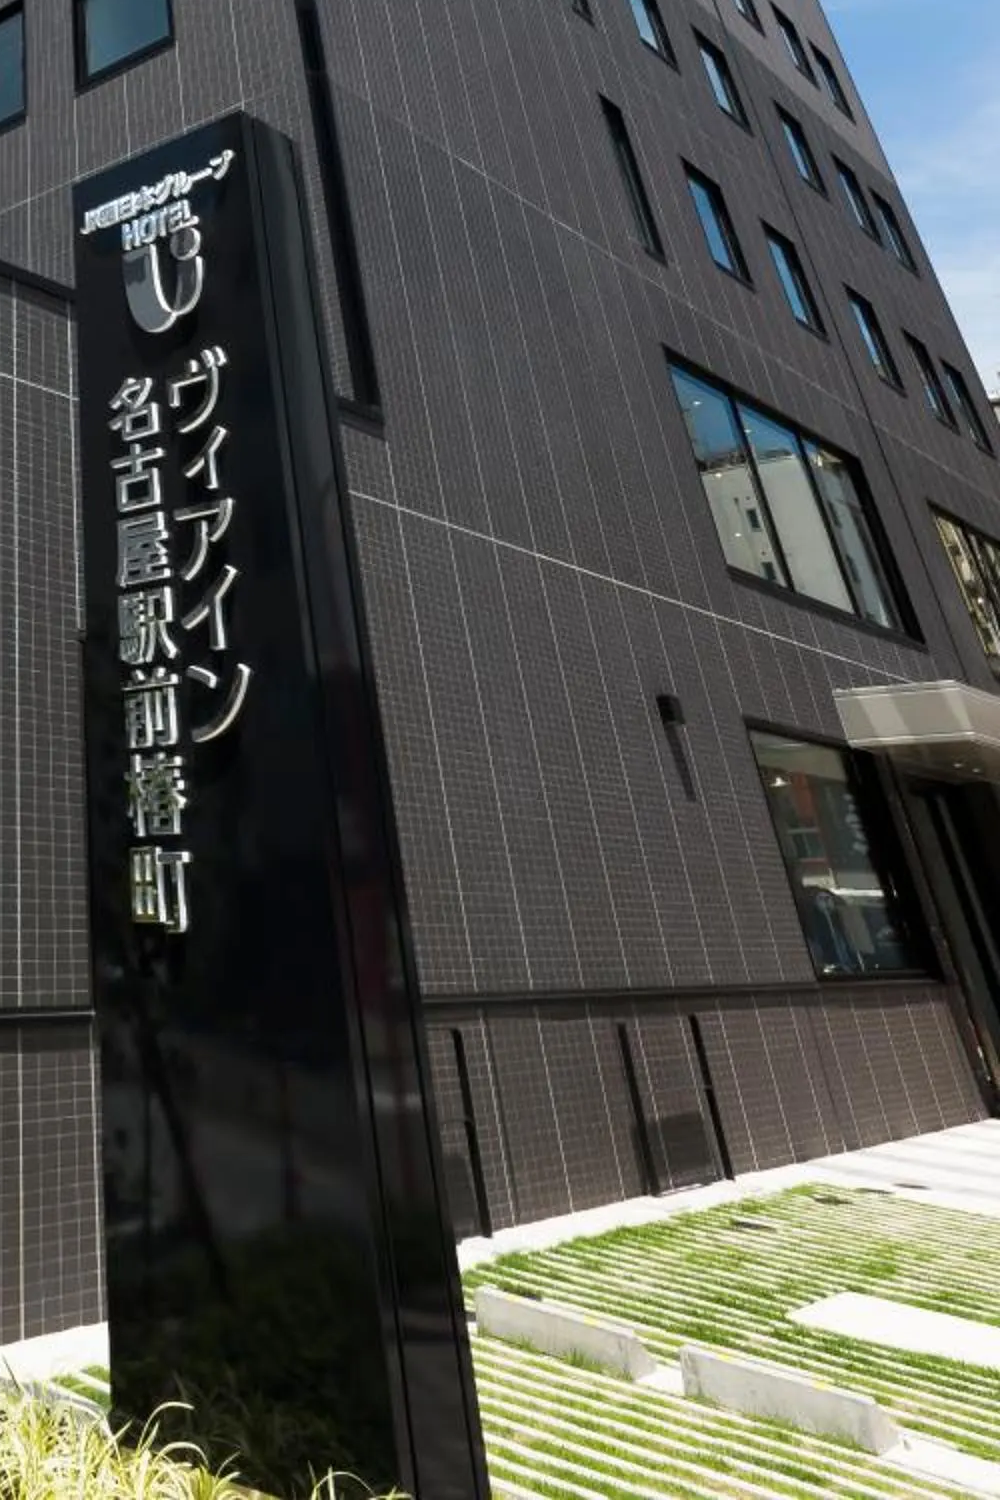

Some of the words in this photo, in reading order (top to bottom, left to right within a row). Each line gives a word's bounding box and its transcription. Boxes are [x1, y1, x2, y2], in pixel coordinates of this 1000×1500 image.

[121, 200, 200, 251] HOTEL
[109, 377, 192, 932] 名古屋駅前椿町
[168, 346, 252, 743] ヴィアイン
